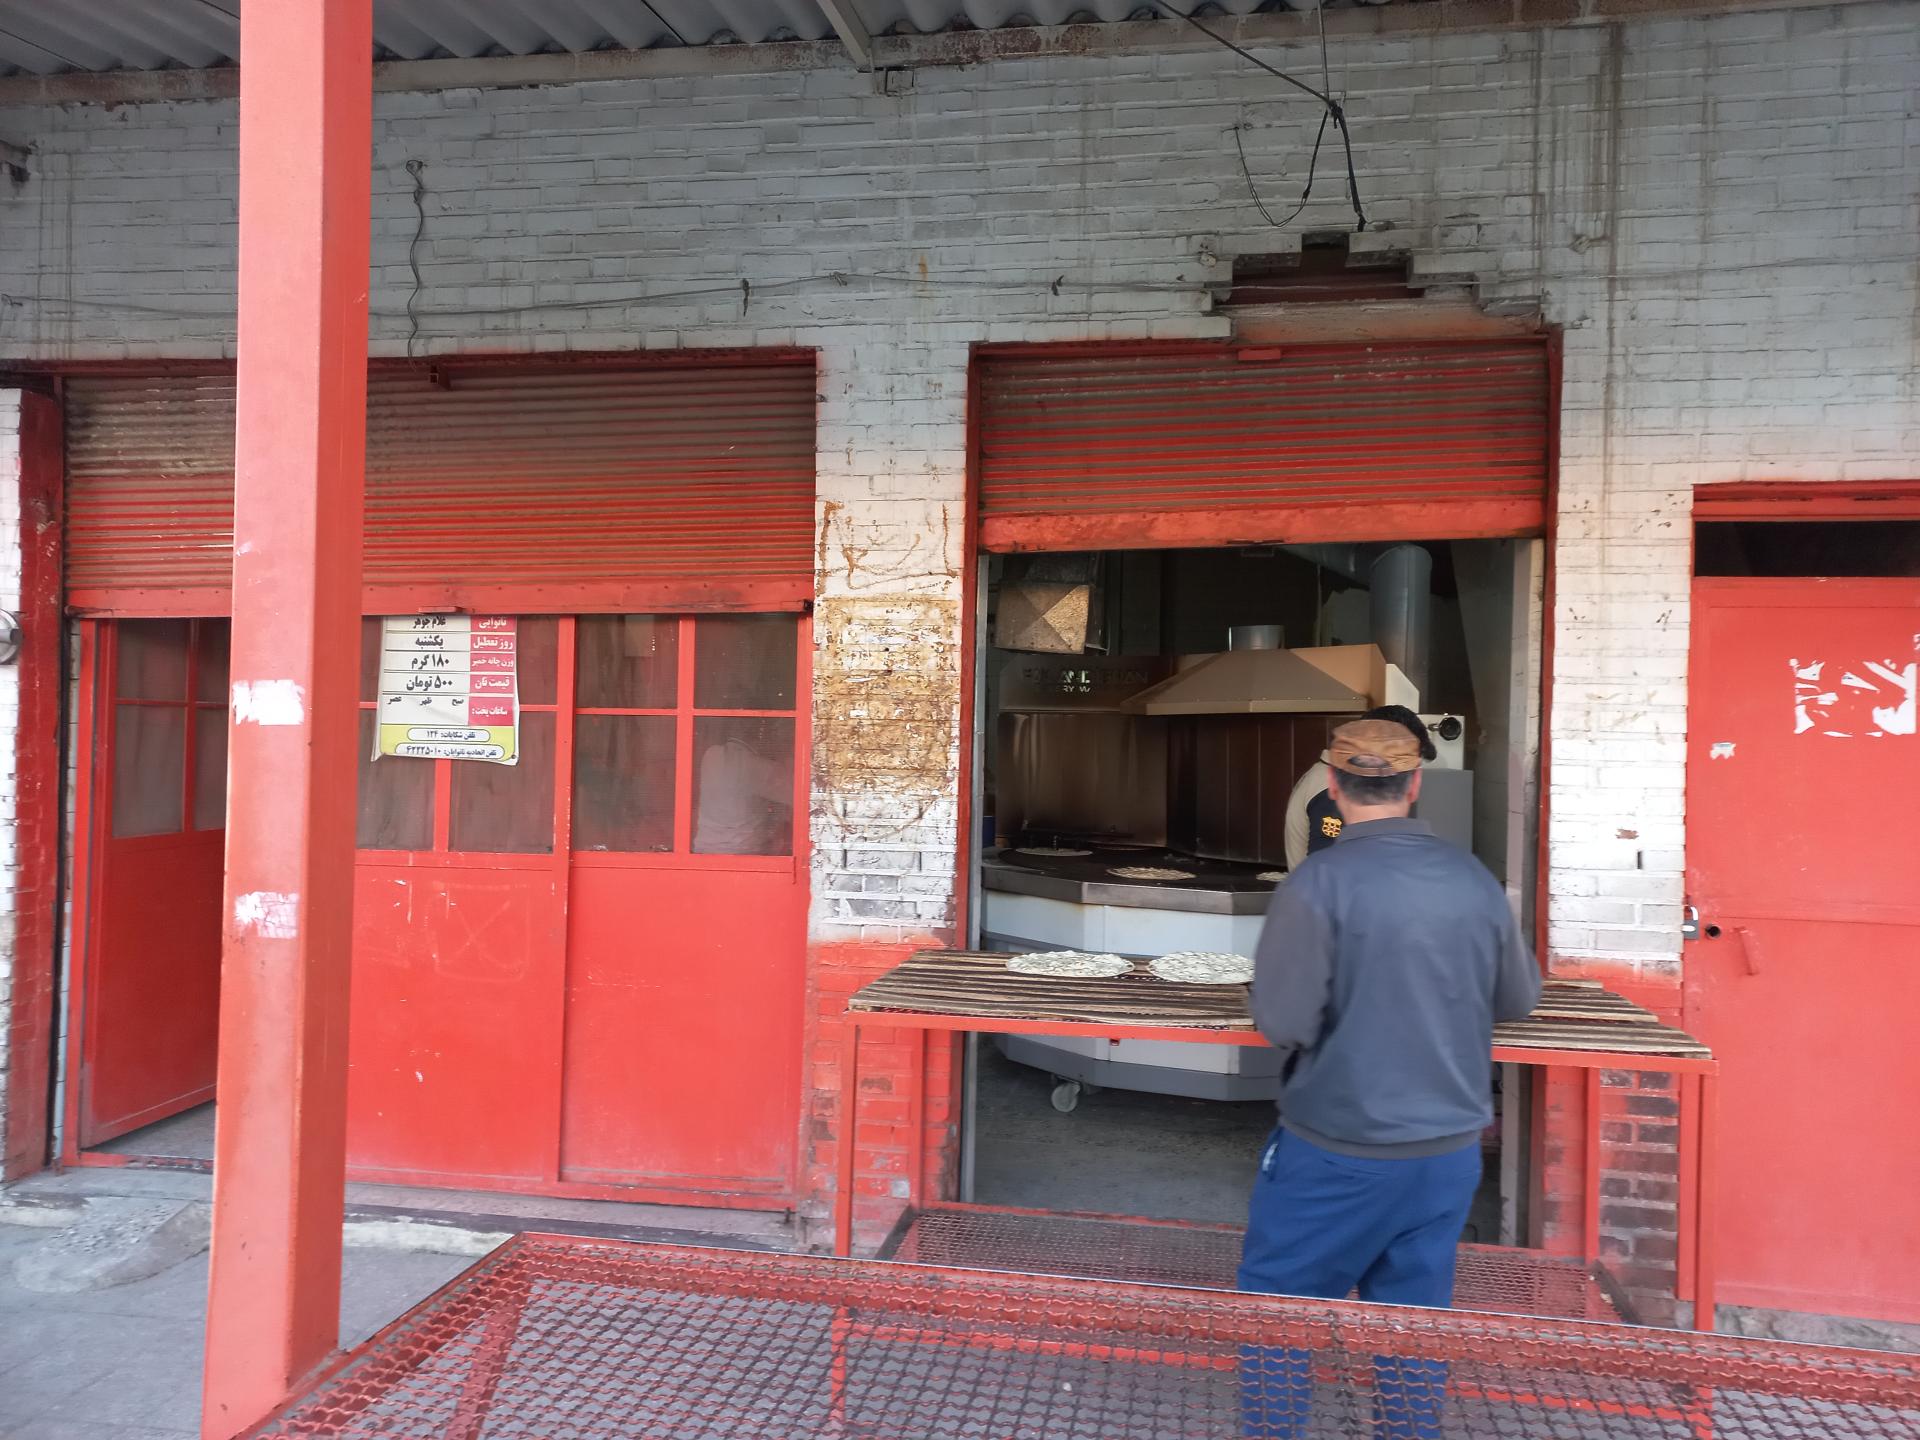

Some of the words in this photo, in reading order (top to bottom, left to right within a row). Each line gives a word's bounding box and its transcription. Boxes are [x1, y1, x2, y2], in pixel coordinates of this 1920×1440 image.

[415, 635, 444, 649] یکشنبه
[473, 636, 498, 649] تعطیل
[499, 639, 513, 650] روز
[411, 654, 430, 670] گرم
[432, 654, 450, 667] ۱۸۰
[406, 675, 433, 691] تومان
[434, 675, 453, 688] ۵۰۰
[474, 676, 489, 690] نان
[490, 676, 510, 690] قیمت
